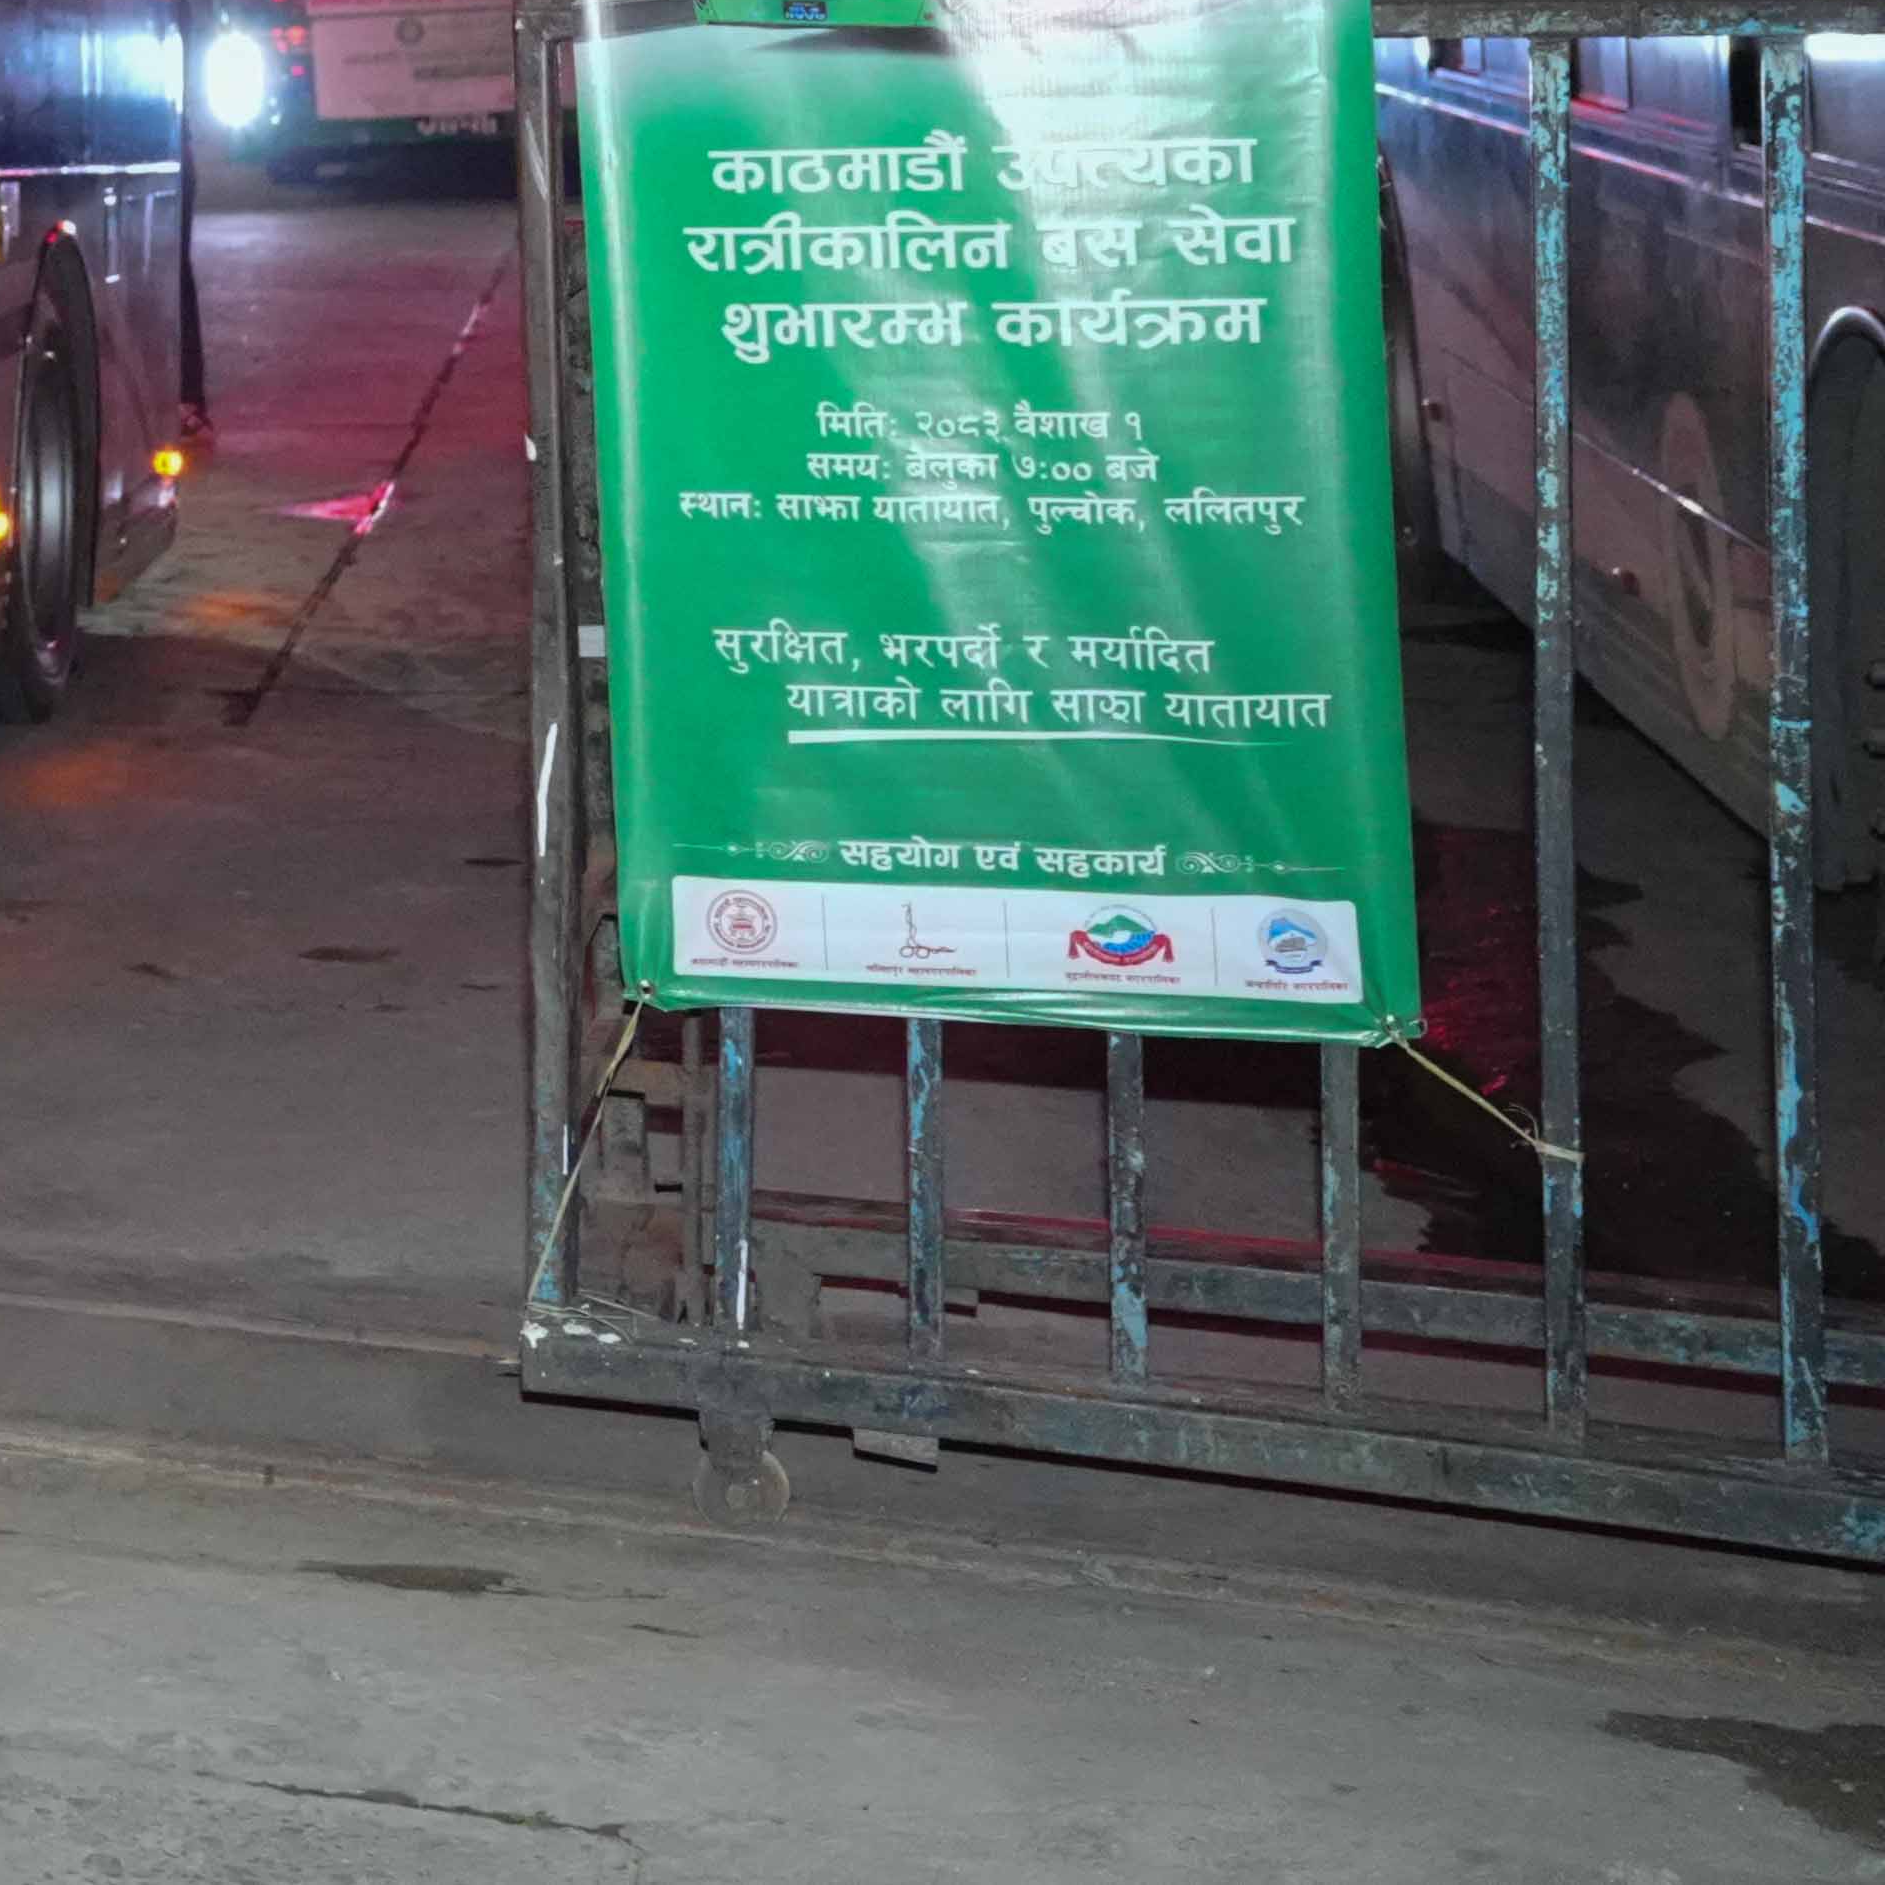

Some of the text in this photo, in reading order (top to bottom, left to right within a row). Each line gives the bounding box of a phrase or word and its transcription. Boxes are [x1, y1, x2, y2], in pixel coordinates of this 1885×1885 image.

[708, 130, 1257, 193] काठमाडौं उपत्यका
[683, 205, 1296, 274] रात्रीकालिन बस सेवा
[721, 289, 1267, 363] शुभारम्भ कार्यक्रम
[905, 442, 999, 490] बेलुका
[1012, 455, 1092, 481] ७:००
[1105, 448, 1160, 482] बजे
[873, 495, 1010, 530] यातायात,
[1163, 486, 1305, 535] ललितपुर
[713, 619, 1214, 674] सुरक्षित, भरपर्दो र मर्यादित
[787, 676, 922, 722] यात्राको
[940, 677, 1033, 723] लागि
[1164, 693, 1331, 729] यातायात
[838, 835, 1166, 878] सहयोग एवं सहकार्य
